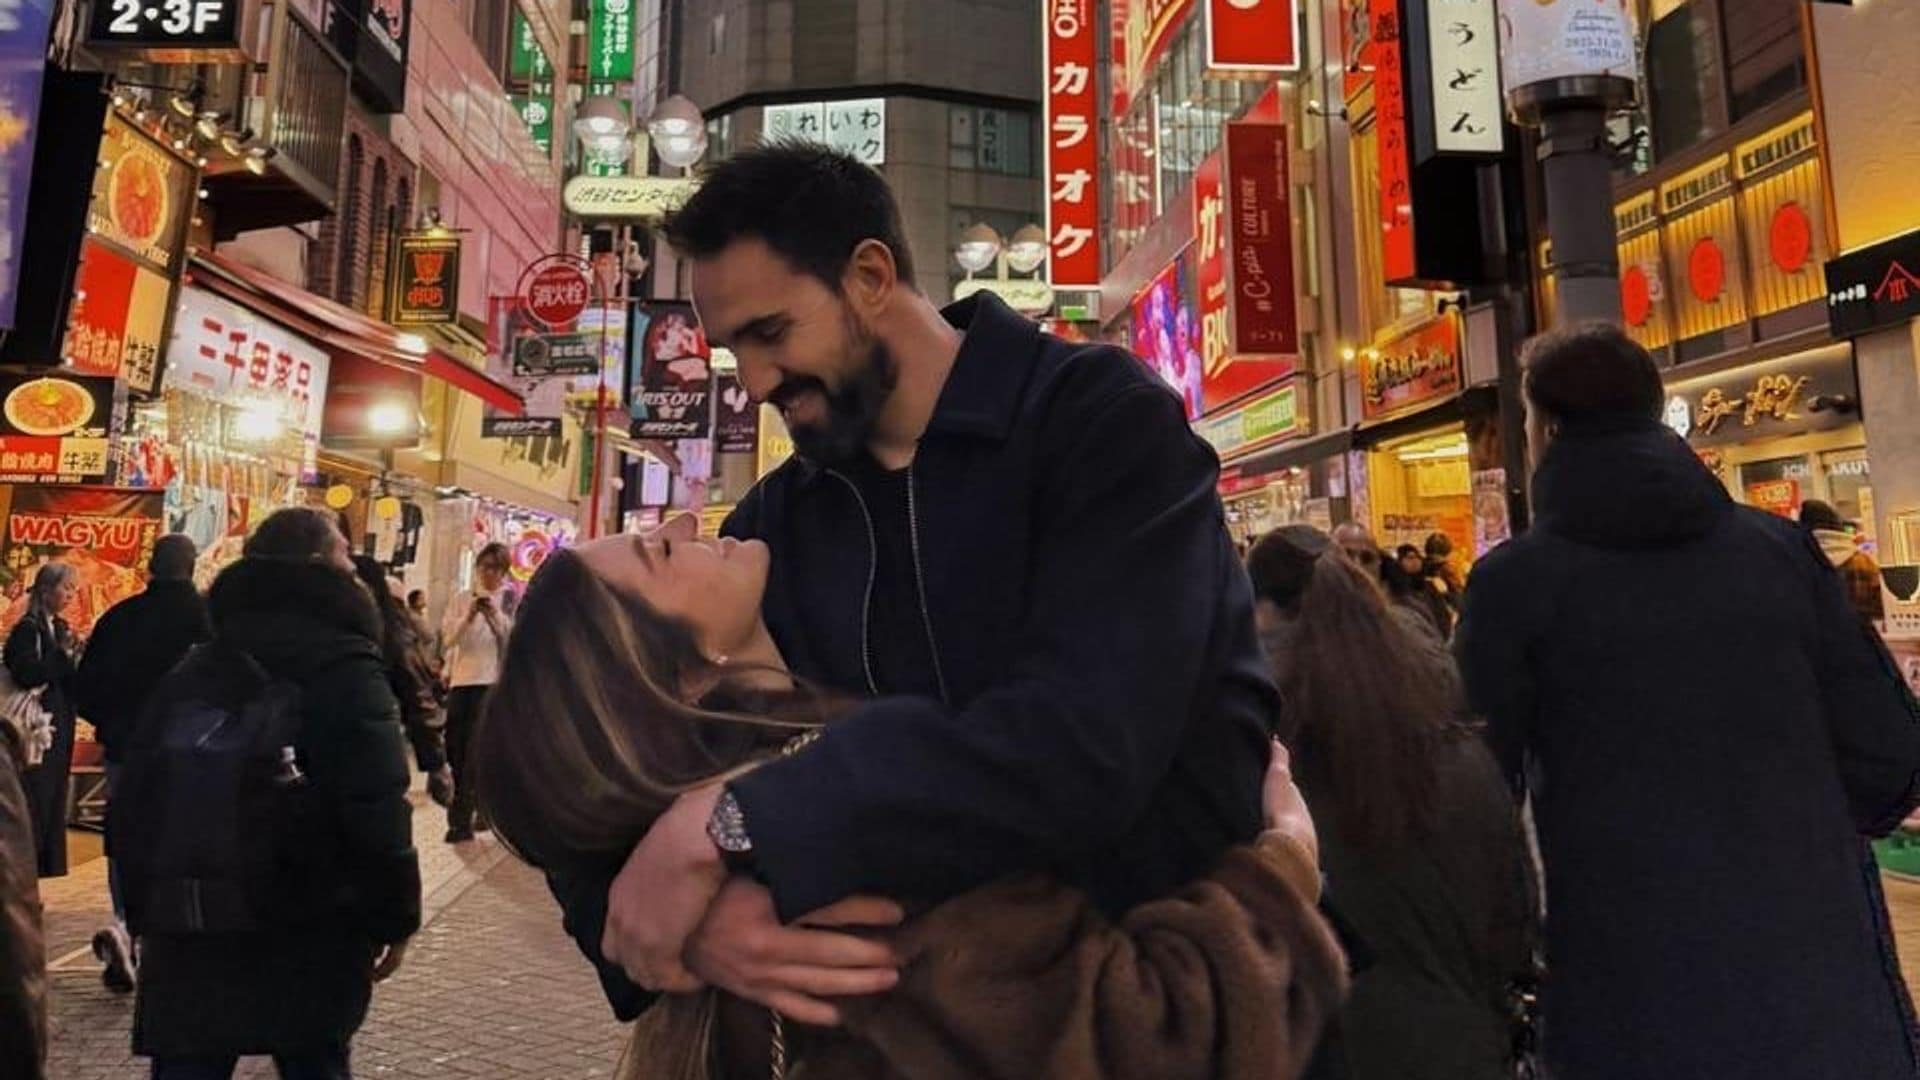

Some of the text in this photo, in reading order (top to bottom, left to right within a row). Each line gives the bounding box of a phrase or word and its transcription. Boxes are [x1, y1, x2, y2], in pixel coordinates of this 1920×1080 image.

[1446, 21, 1486, 135] うどん
[1051, 61, 1093, 259] カラオケ
[532, 282, 585, 308] 消火栓
[670, 391, 705, 406] OUT
[10, 513, 140, 549] WAGYU
